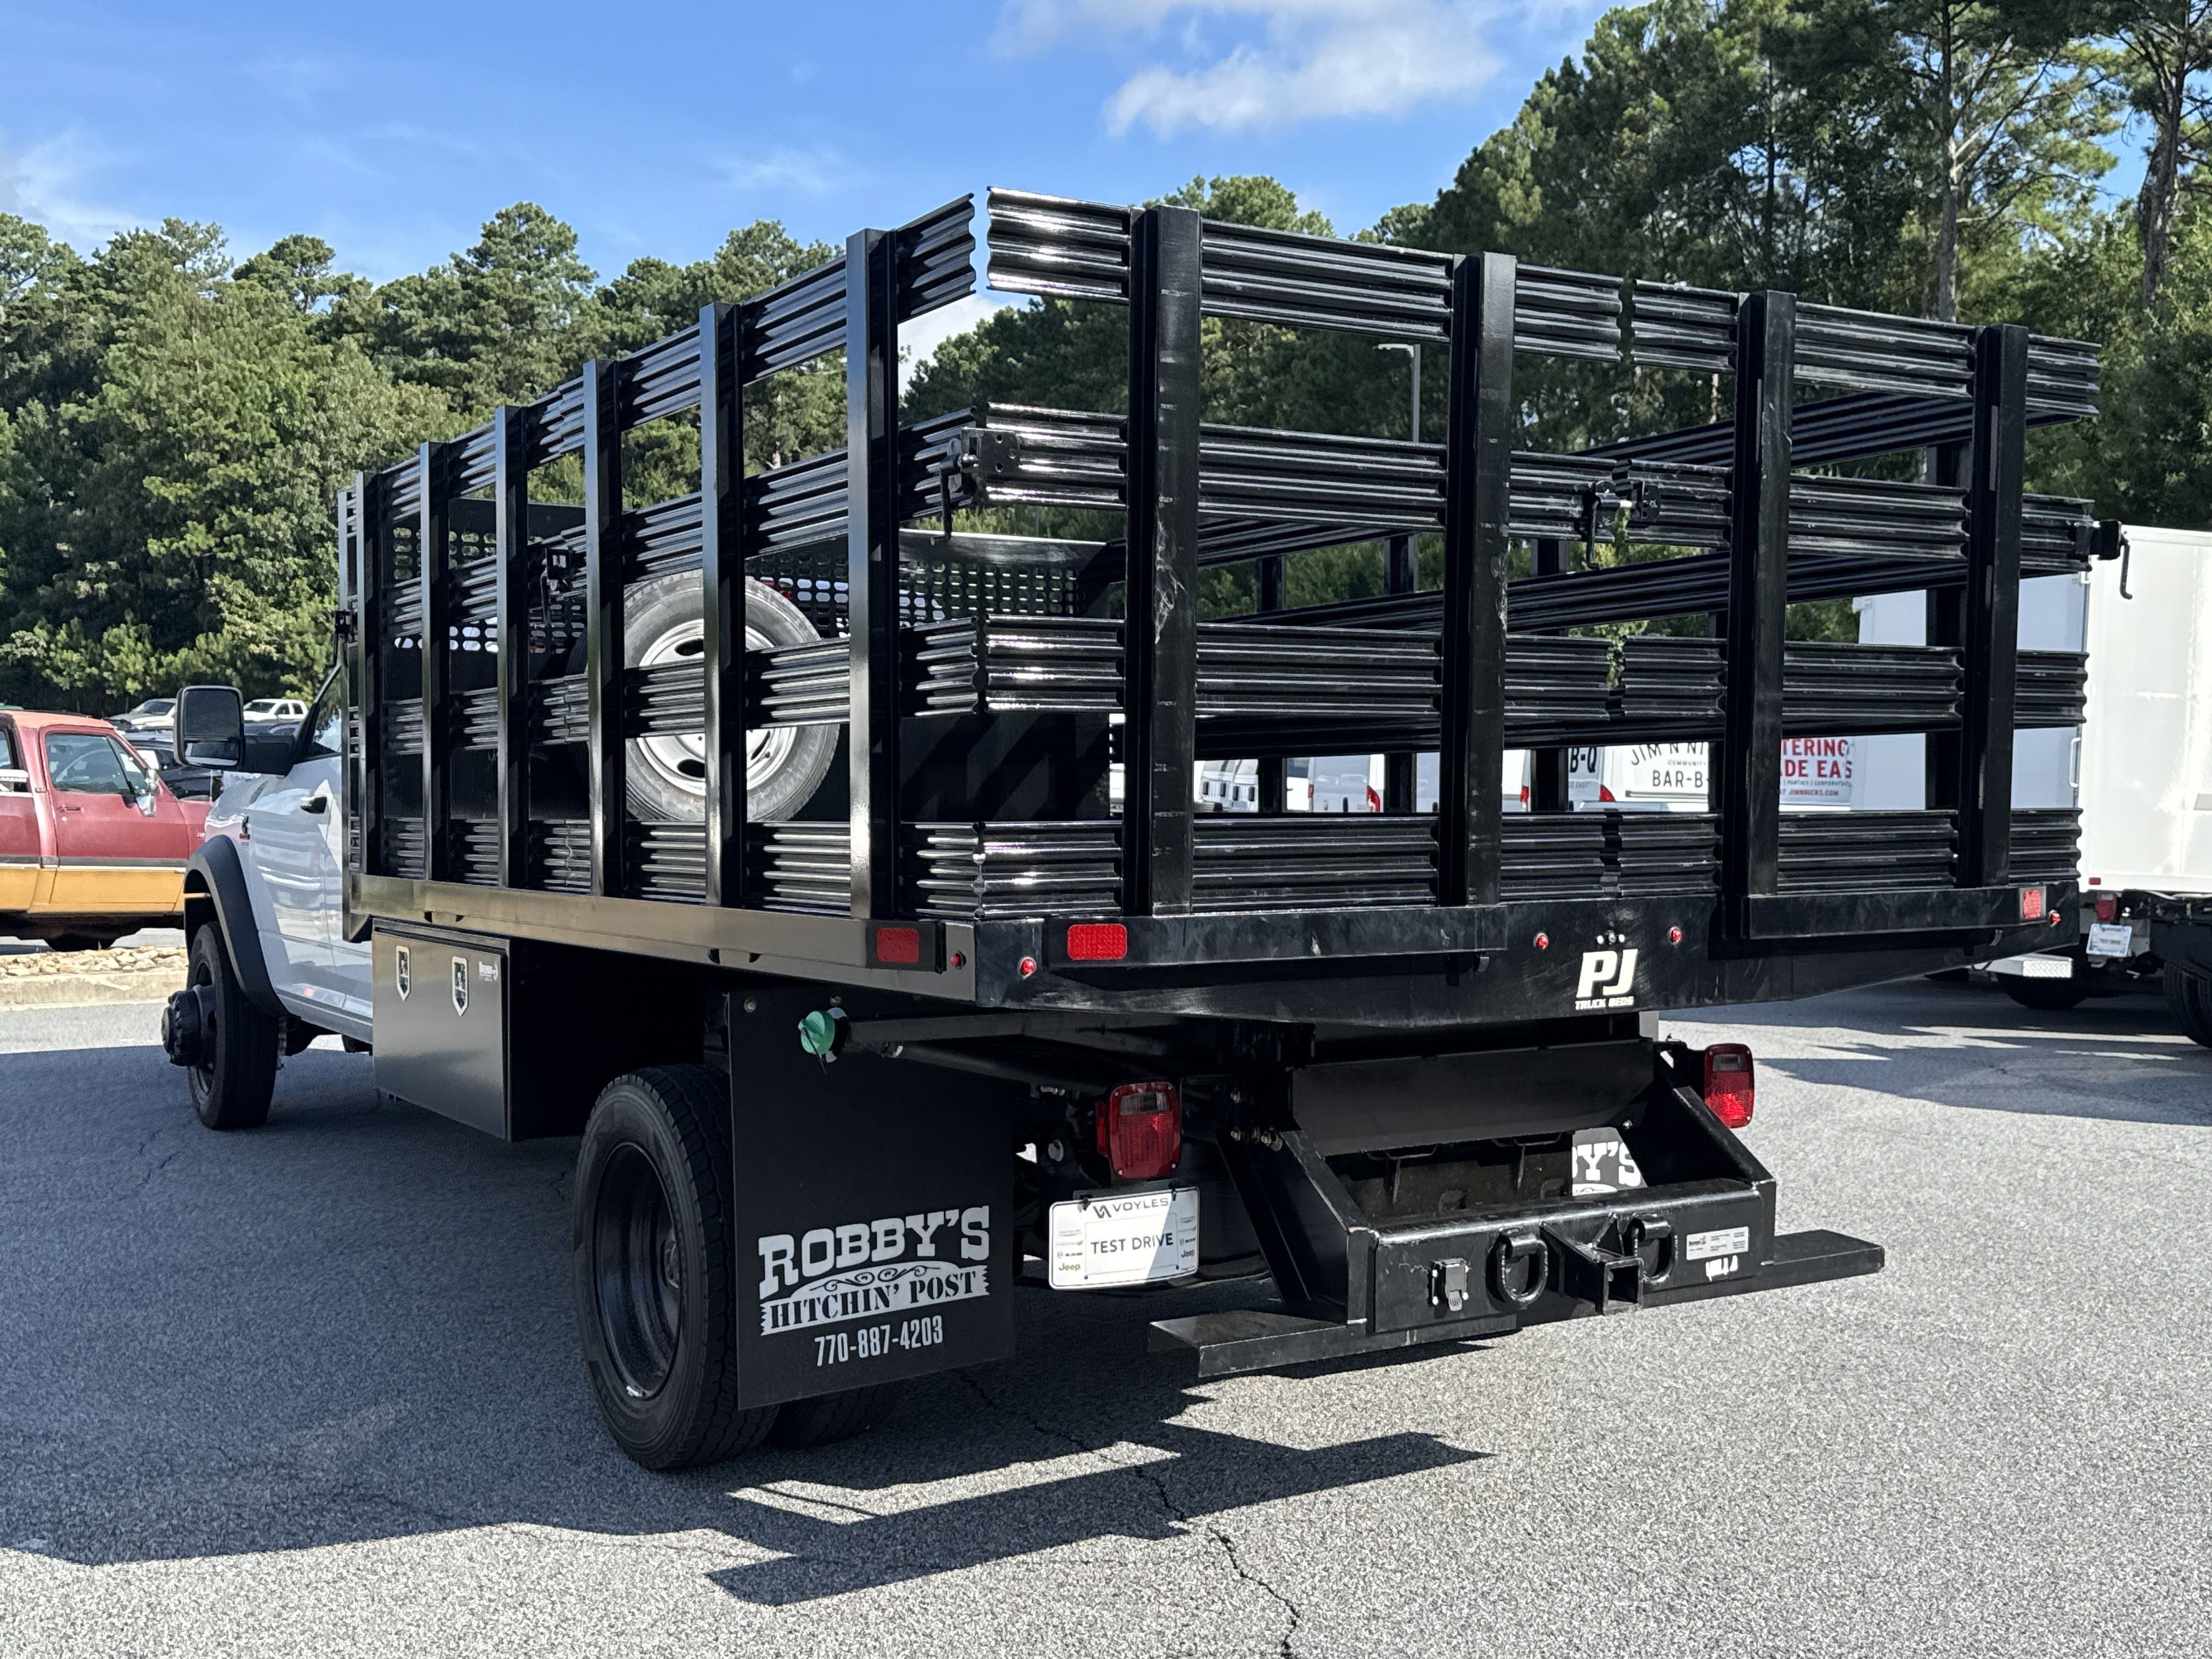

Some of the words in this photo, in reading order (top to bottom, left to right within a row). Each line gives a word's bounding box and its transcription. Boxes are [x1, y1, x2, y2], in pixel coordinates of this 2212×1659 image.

[1631, 744, 1662, 765] JIM
[1780, 759, 1808, 777] DE
[1576, 949, 1638, 998] PJ
[1113, 1198, 1169, 1212] VOYLES
[758, 1205, 990, 1299] ROBBY'S
[1090, 1239, 1126, 1254] TEST
[1132, 1232, 1174, 1250] DRIVE
[1058, 1262, 1081, 1272] Jeep
[770, 1284, 900, 1329] HITCHIN'
[909, 1270, 977, 1304] POST
[814, 1315, 944, 1367] 770-887-4203
